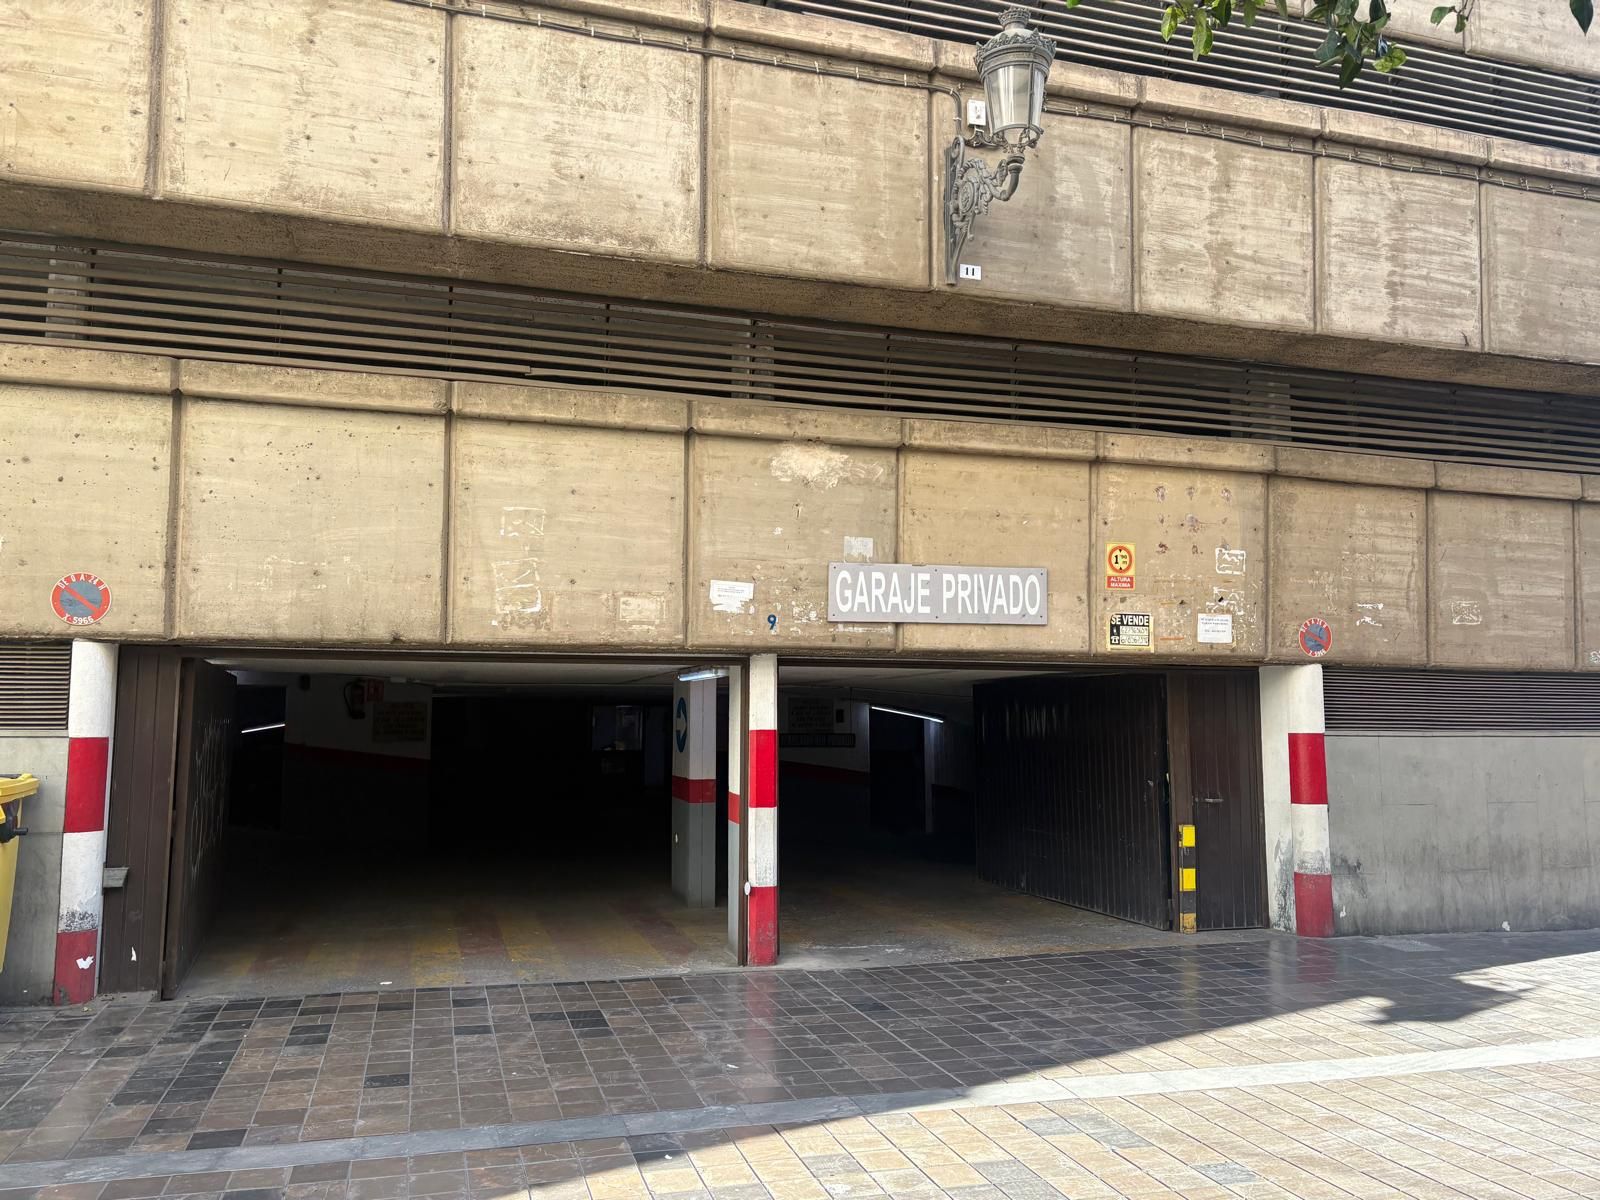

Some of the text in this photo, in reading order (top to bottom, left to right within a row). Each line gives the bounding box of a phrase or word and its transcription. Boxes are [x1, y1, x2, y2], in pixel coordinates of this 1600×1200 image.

[965, 266, 975, 276] 11
[58, 577, 69, 589] DE
[835, 570, 1041, 616] GARAJE PRIVADO
[767, 613, 777, 630] 9
[1110, 614, 1149, 626] SE VENDE
